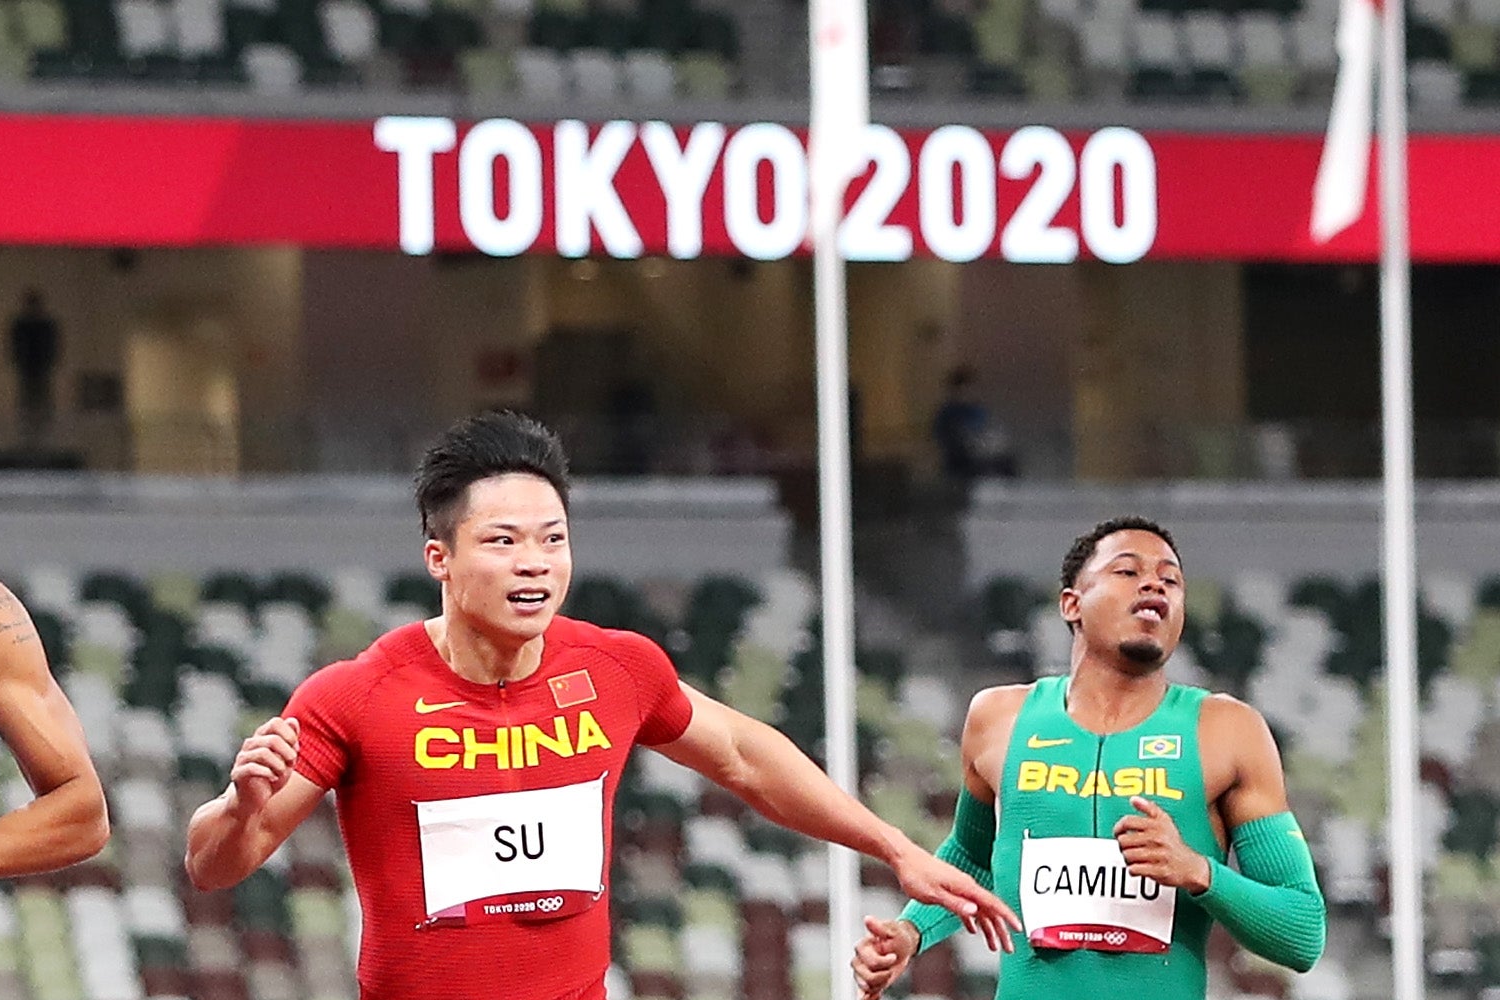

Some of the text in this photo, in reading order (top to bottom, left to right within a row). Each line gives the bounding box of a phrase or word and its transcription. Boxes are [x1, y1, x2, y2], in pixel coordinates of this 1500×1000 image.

[373, 115, 1159, 264] TOKYO 2020
[415, 711, 612, 770] CHINA
[1017, 760, 1184, 800] BRASIL
[493, 821, 545, 862] SU
[483, 903, 513, 915] TOKYO
